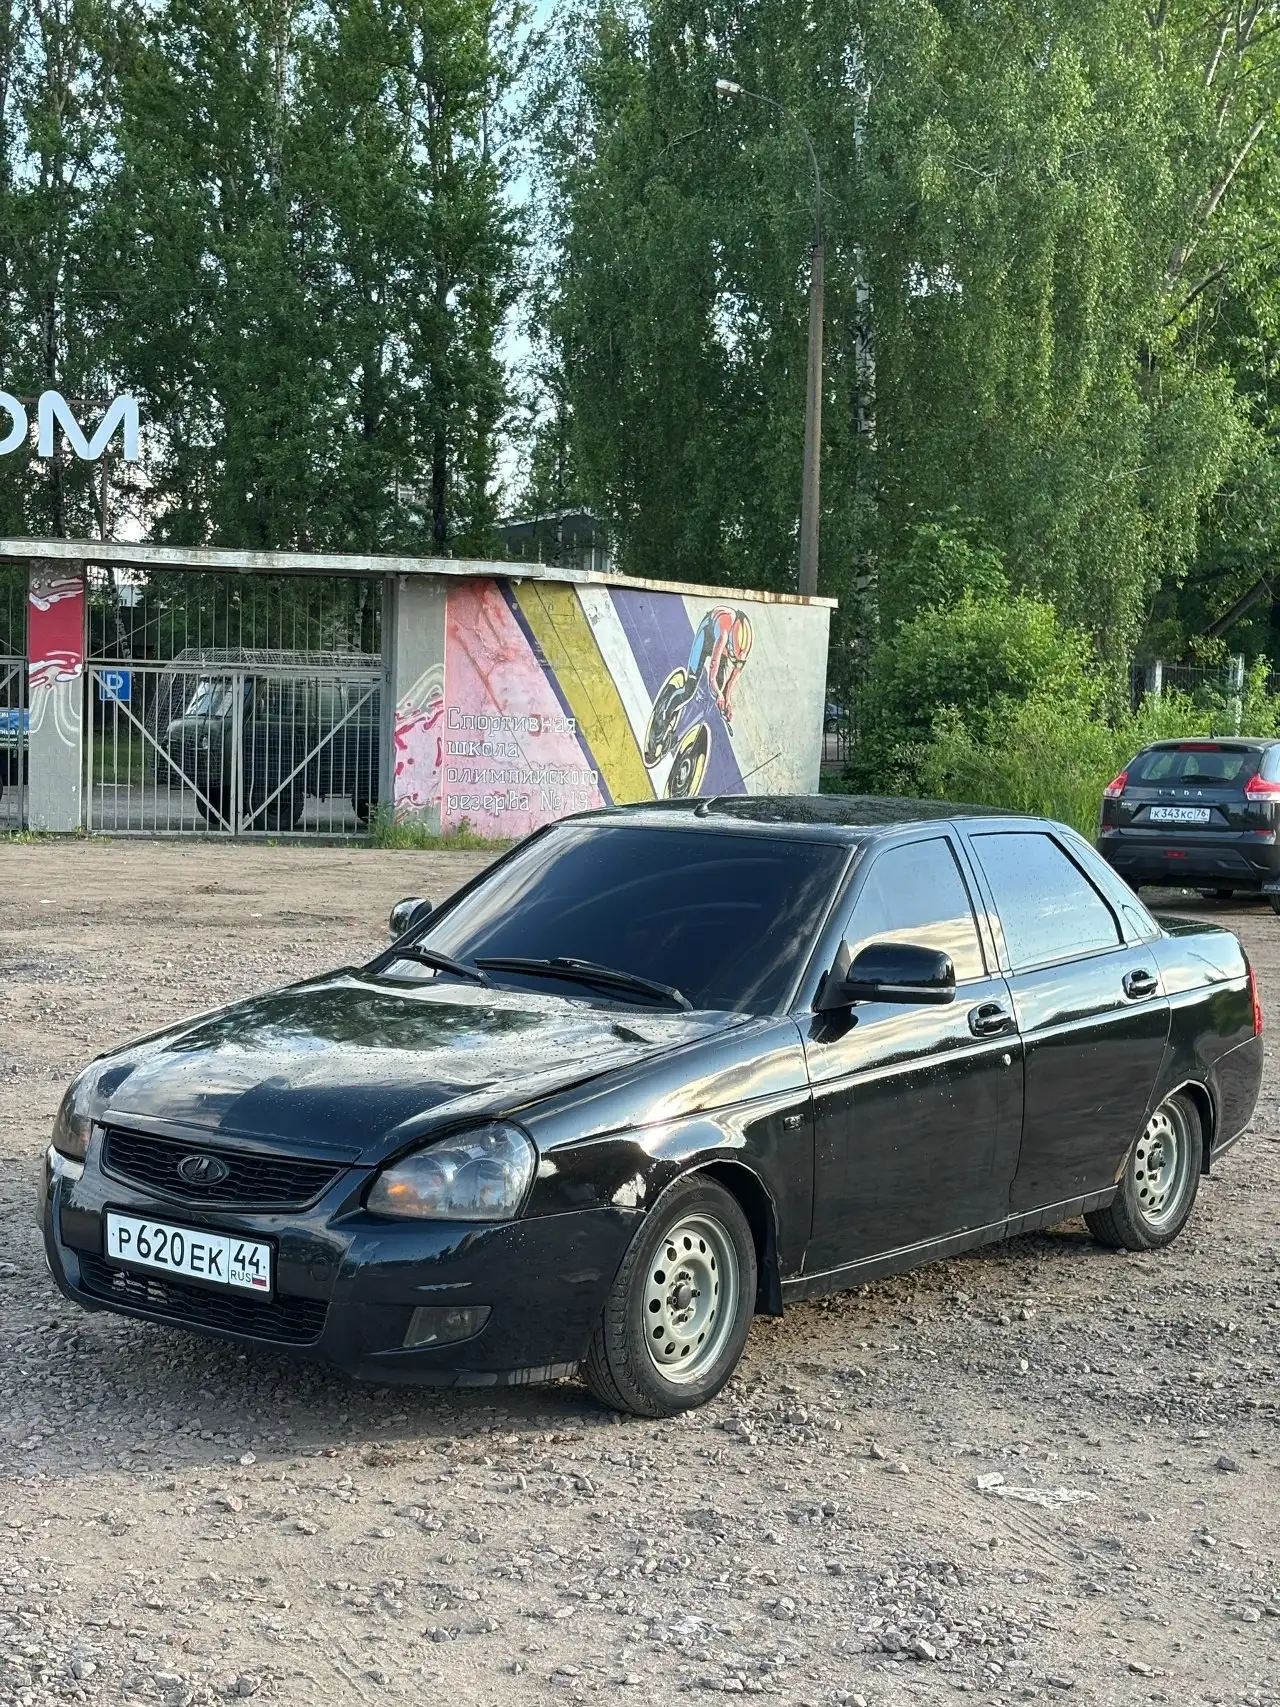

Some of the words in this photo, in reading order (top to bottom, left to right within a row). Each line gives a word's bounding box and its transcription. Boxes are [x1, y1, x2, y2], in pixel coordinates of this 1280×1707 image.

[447, 707, 577, 737] Спортивная
[446, 741, 519, 757] школа
[446, 765, 599, 785] олимпийского
[446, 790, 530, 816] резерва
[569, 792, 588, 811] 19
[1196, 809, 1207, 817] 76
[118, 1224, 224, 1277] Р620ЕК
[233, 1243, 260, 1275] 44
[230, 1269, 251, 1283] RUS
